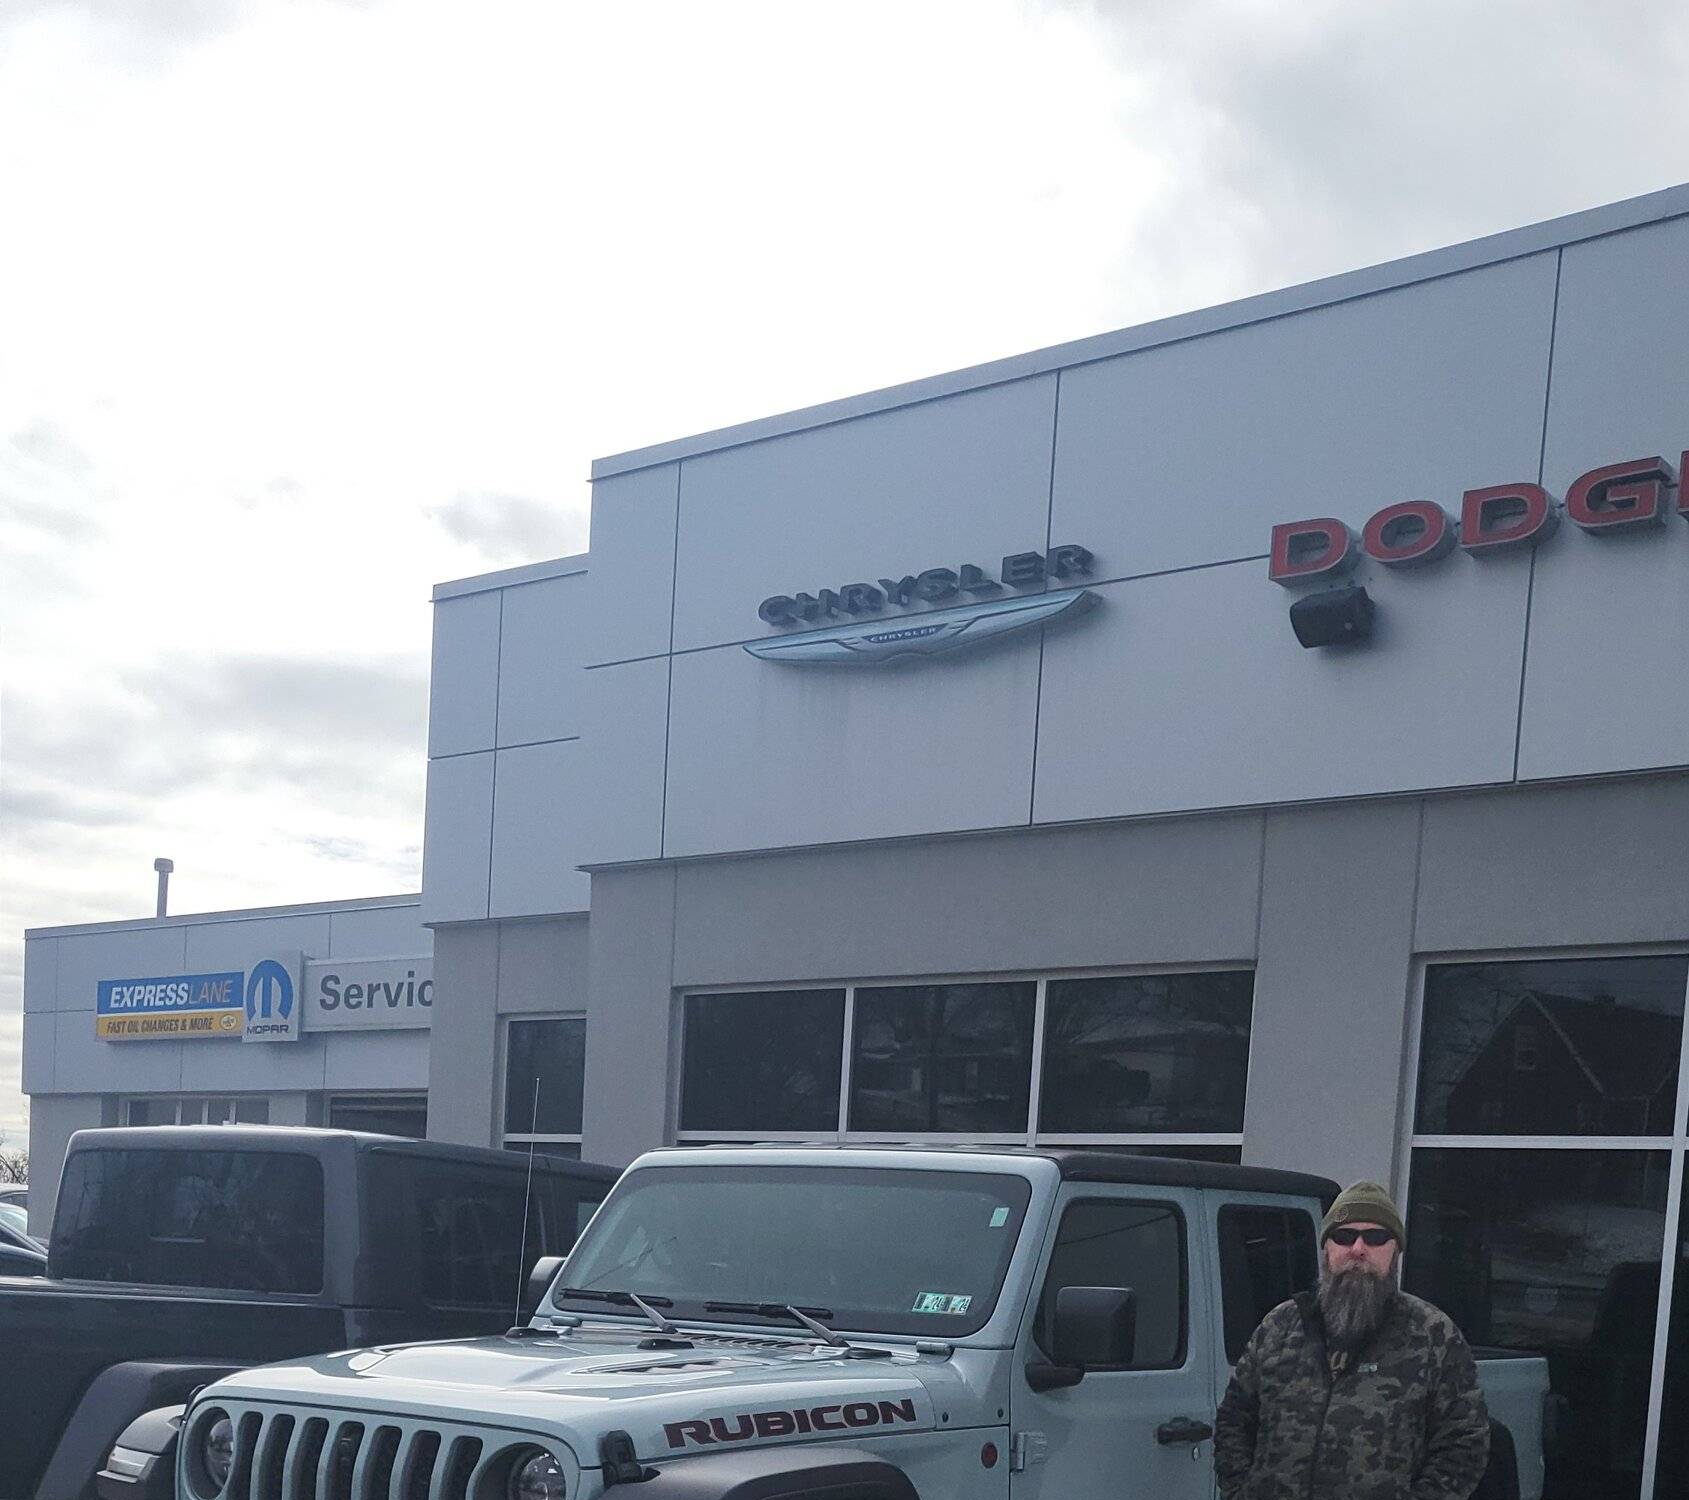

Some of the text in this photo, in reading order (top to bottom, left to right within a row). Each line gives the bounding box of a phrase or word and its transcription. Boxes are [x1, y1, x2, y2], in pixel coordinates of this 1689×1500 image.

[1268, 449, 1689, 587] DODG
[758, 544, 1096, 627] CHRYSLER
[106, 1020, 126, 1033] FAST
[127, 1019, 139, 1033] OIL
[141, 1017, 179, 1033] CHANGES
[189, 1017, 214, 1030] MORE
[246, 1024, 289, 1034] MOPAR
[663, 1398, 917, 1449] RUBICON
